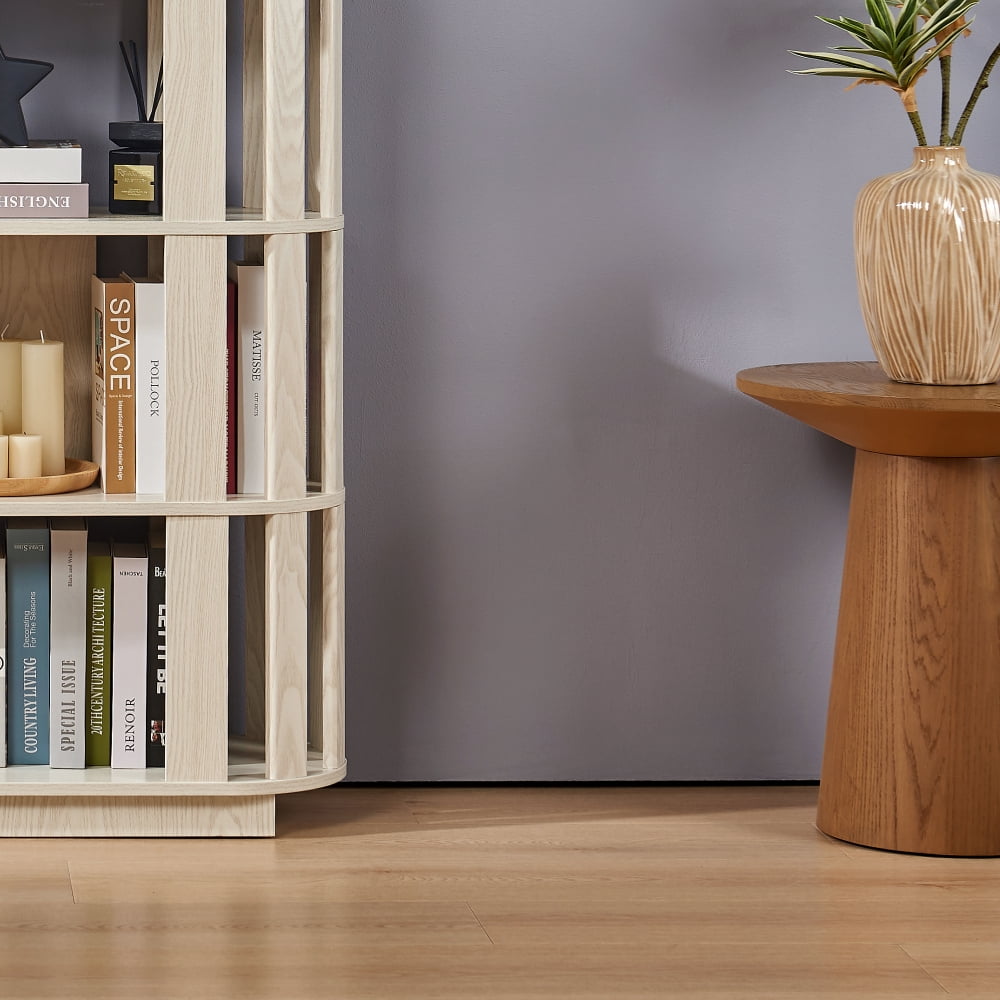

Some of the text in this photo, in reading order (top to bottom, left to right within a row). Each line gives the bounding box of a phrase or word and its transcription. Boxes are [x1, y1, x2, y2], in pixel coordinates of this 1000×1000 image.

[110, 298, 131, 391] SPACE
[252, 330, 262, 381] MATISSE
[150, 360, 159, 417] POLLOCK
[24, 657, 38, 754] COUNTRY LIVING
[61, 659, 76, 752] SPECIAL ISSUE
[125, 698, 136, 752] RENOIR
